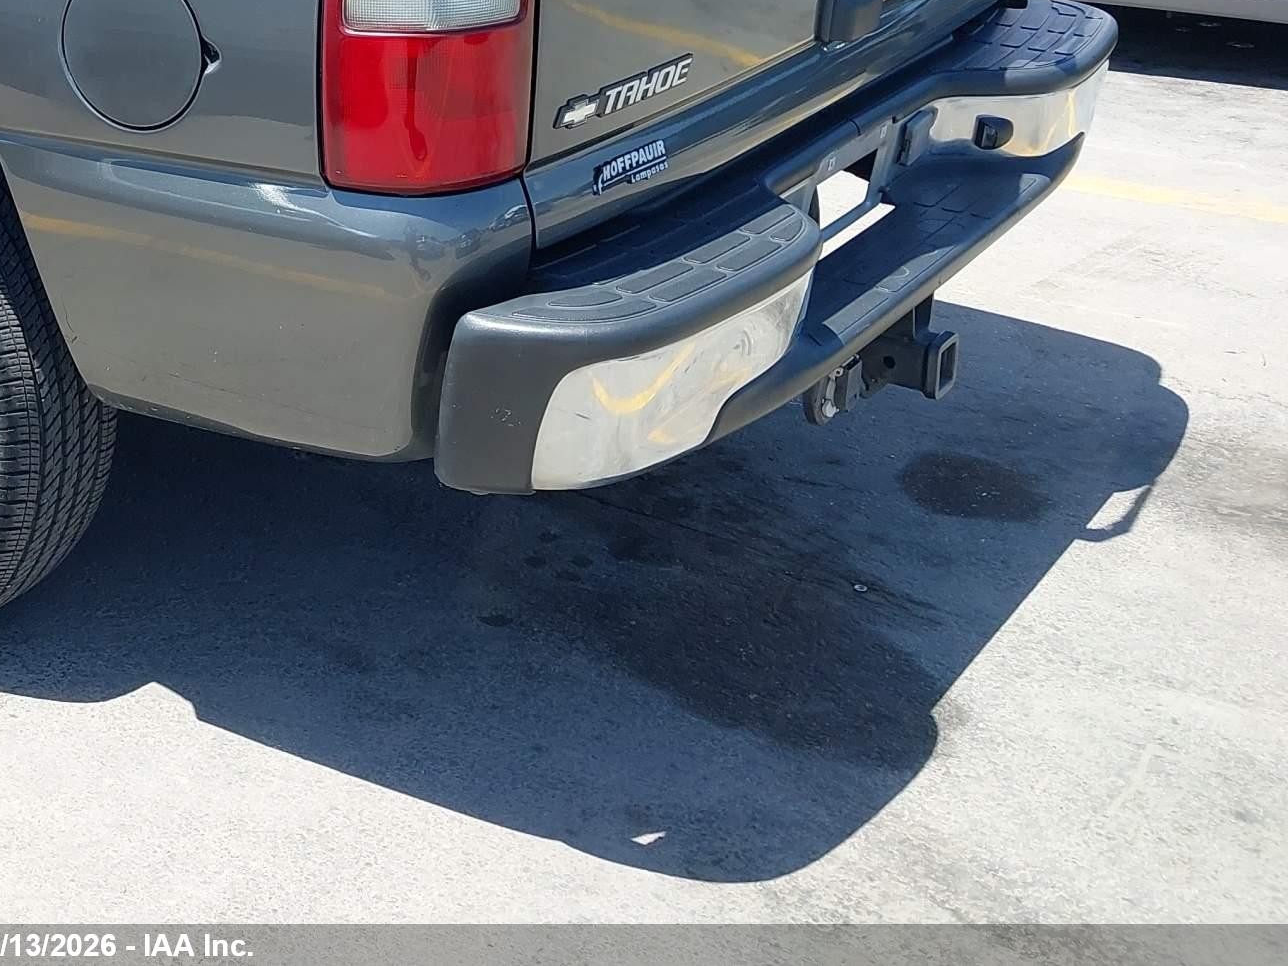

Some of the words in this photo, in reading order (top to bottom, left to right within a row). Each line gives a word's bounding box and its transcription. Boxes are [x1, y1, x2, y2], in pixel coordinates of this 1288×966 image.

[604, 57, 693, 115] TAHOE
[603, 139, 666, 181] HOFFPAUIR
[630, 161, 669, 183] Lampasas
